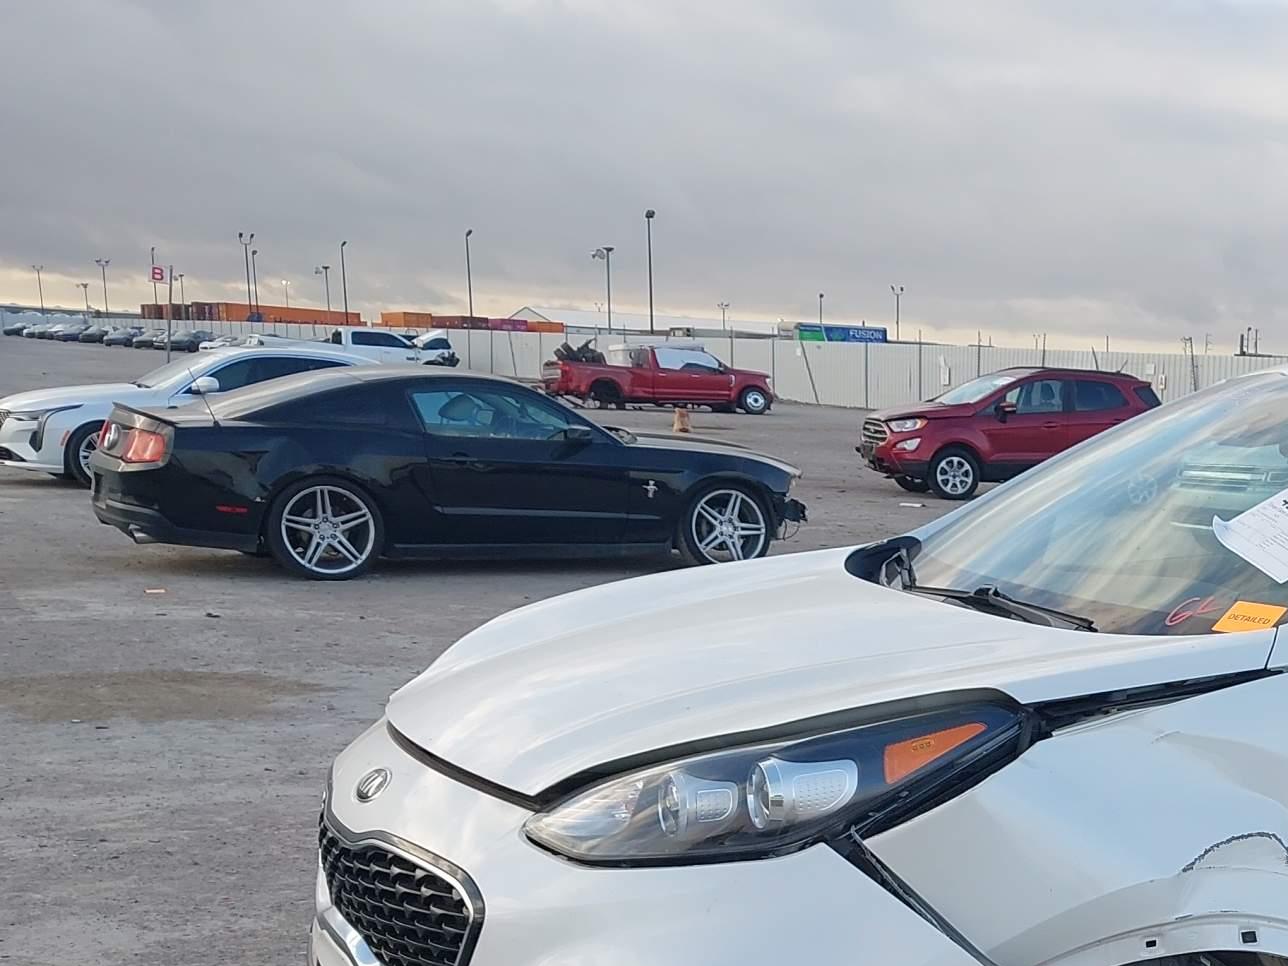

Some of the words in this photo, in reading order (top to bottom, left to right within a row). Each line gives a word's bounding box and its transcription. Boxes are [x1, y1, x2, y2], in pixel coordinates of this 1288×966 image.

[151, 266, 164, 281] B
[849, 328, 883, 340] FUSION
[1227, 612, 1272, 626] DETAILED
